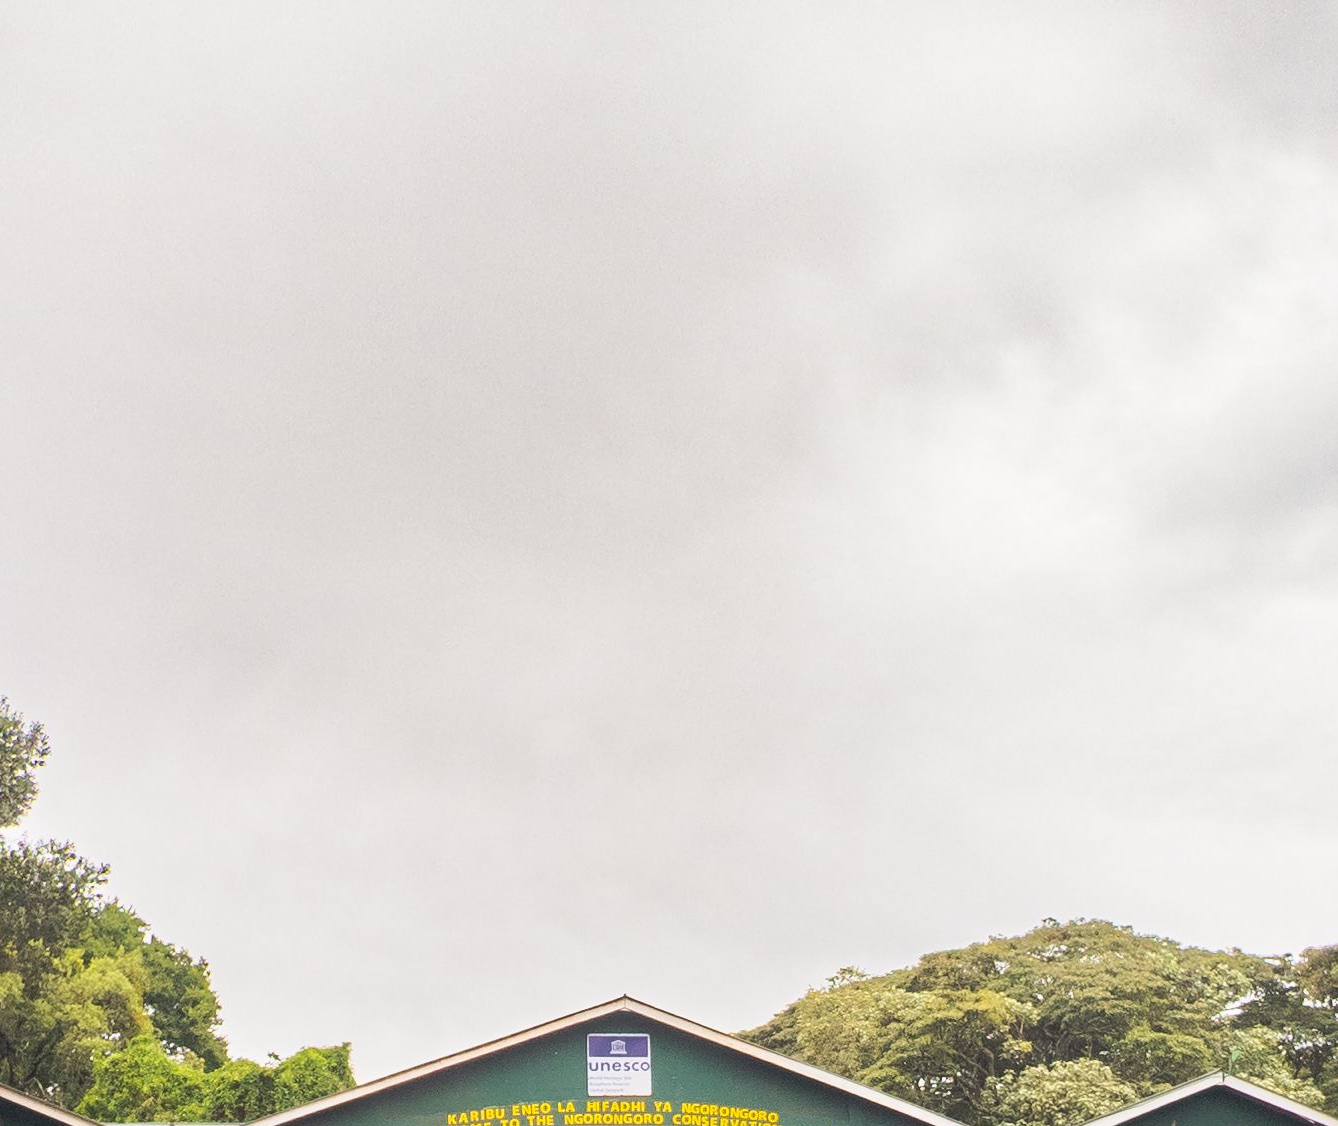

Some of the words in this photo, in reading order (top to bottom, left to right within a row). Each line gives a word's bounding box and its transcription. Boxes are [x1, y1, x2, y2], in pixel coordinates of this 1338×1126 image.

[589, 1061, 650, 1072] unesco
[447, 1107, 505, 1126] KARIBU
[512, 1102, 551, 1116] ENEO
[557, 1102, 575, 1113] LA
[586, 1101, 645, 1113] HIFADHI
[653, 1101, 672, 1113] YA
[681, 1102, 779, 1123] NGORONGORO
[527, 1114, 554, 1126] THE
[564, 1113, 664, 1125] NGORONGORO
